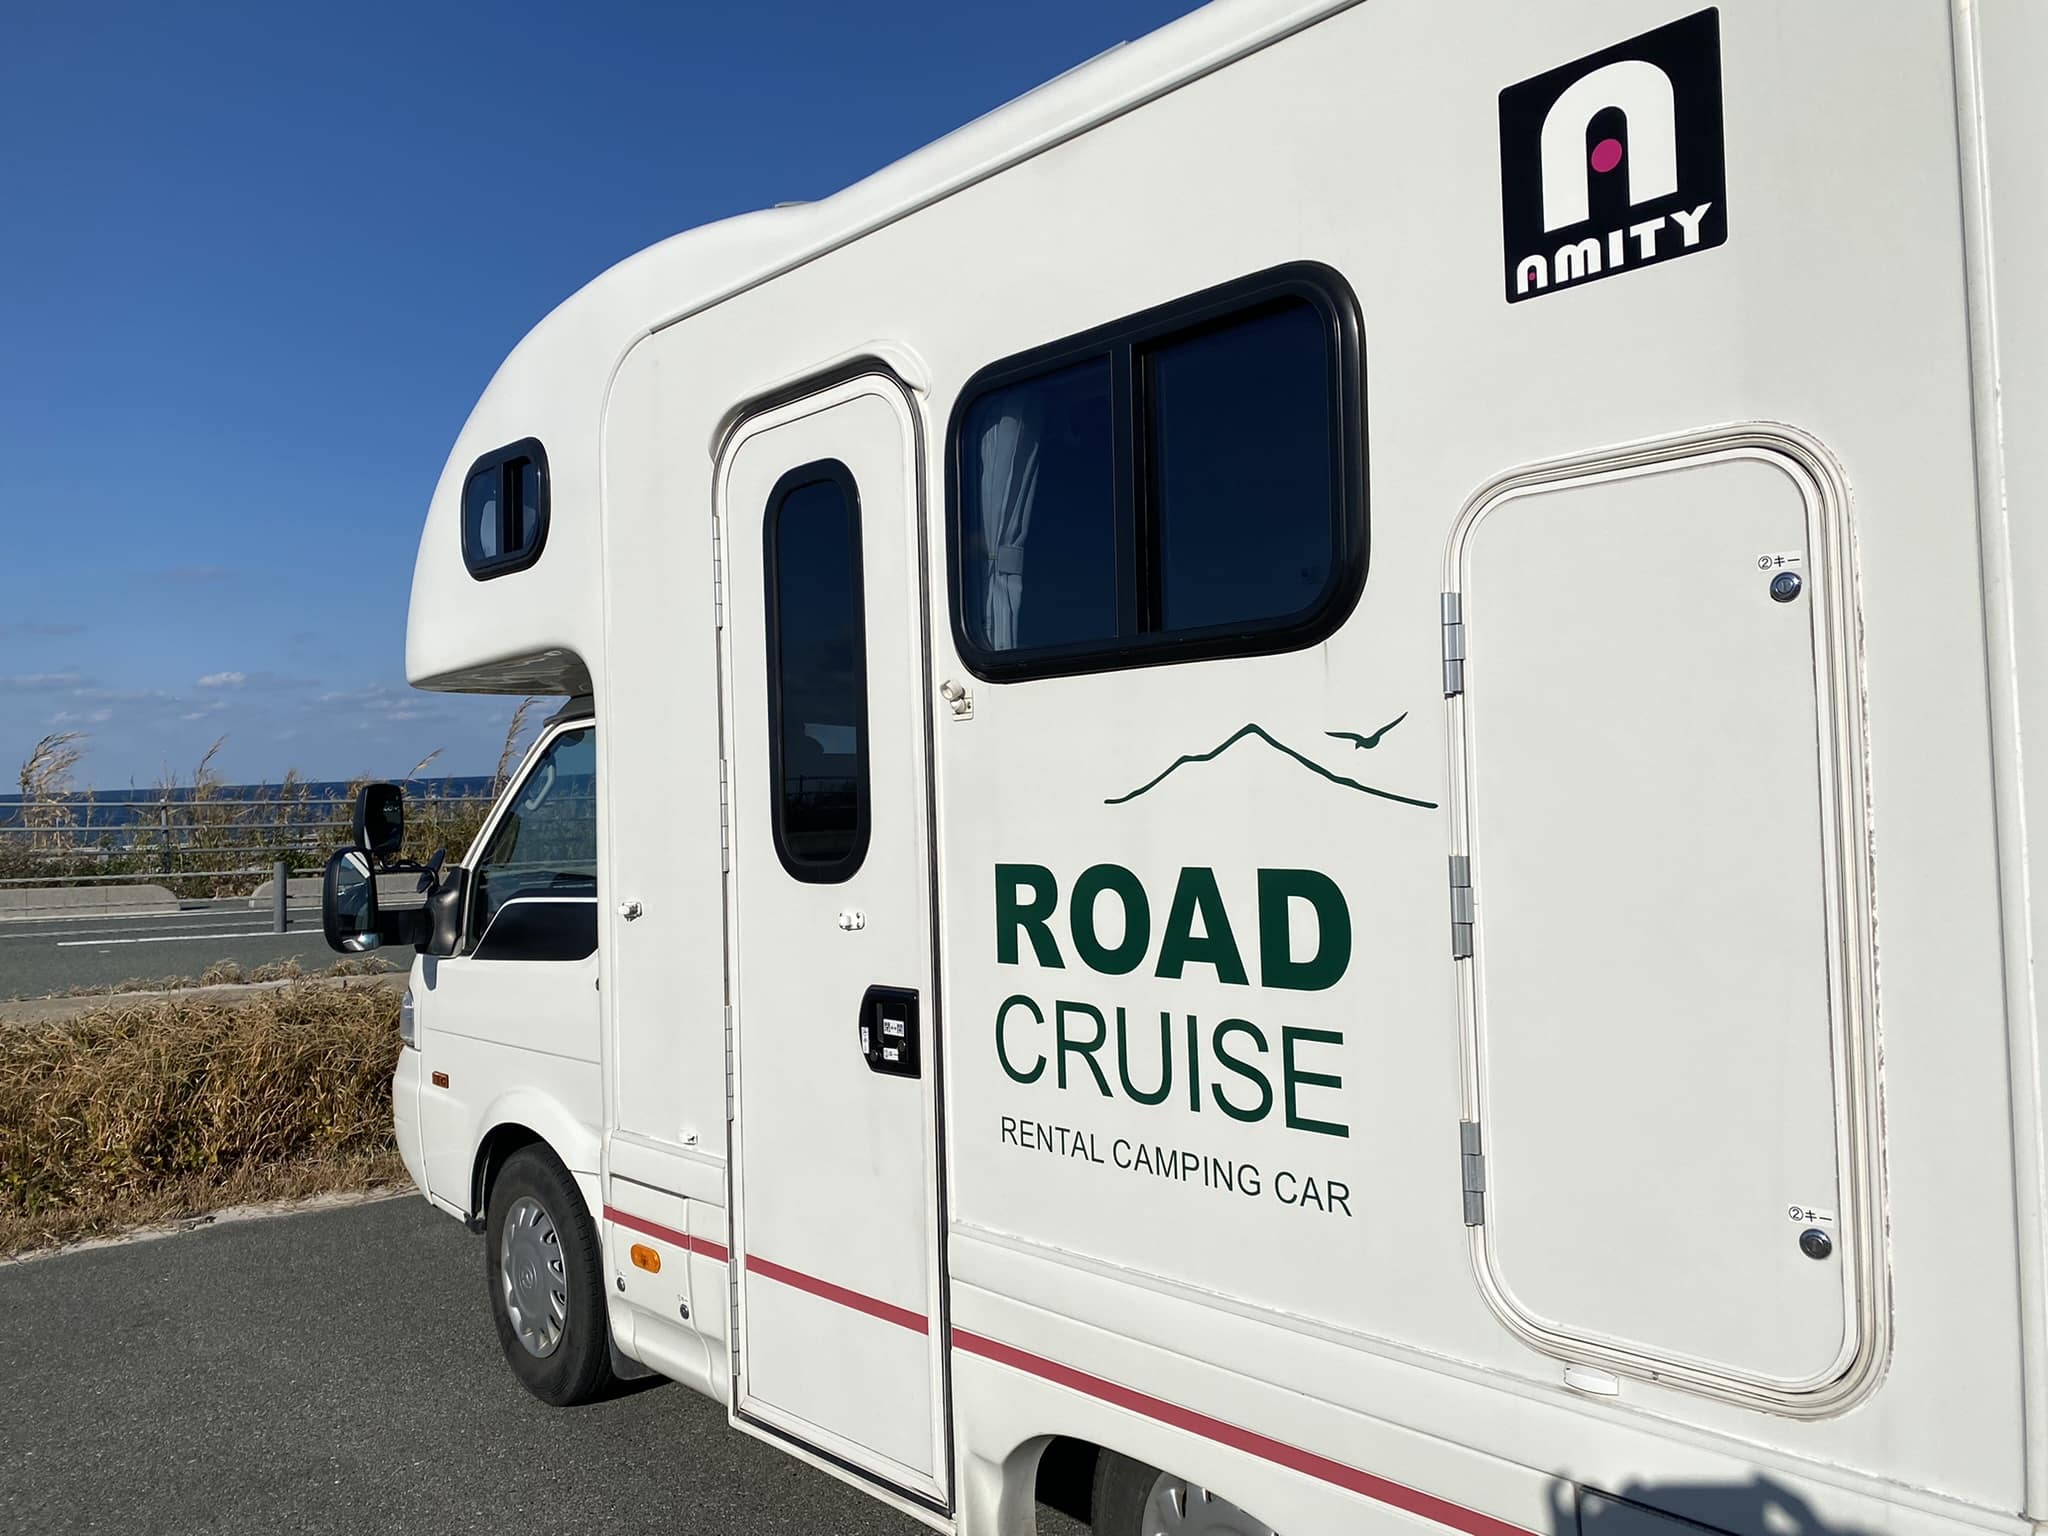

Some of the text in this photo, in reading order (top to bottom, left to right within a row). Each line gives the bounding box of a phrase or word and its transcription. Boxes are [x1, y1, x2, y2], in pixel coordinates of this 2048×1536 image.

[1517, 202, 1712, 294] AMITY
[994, 863, 1352, 991] ROAD
[995, 994, 1349, 1138] CRUISE
[1001, 1116, 1353, 1217] RENTAL CAMPING CAR
